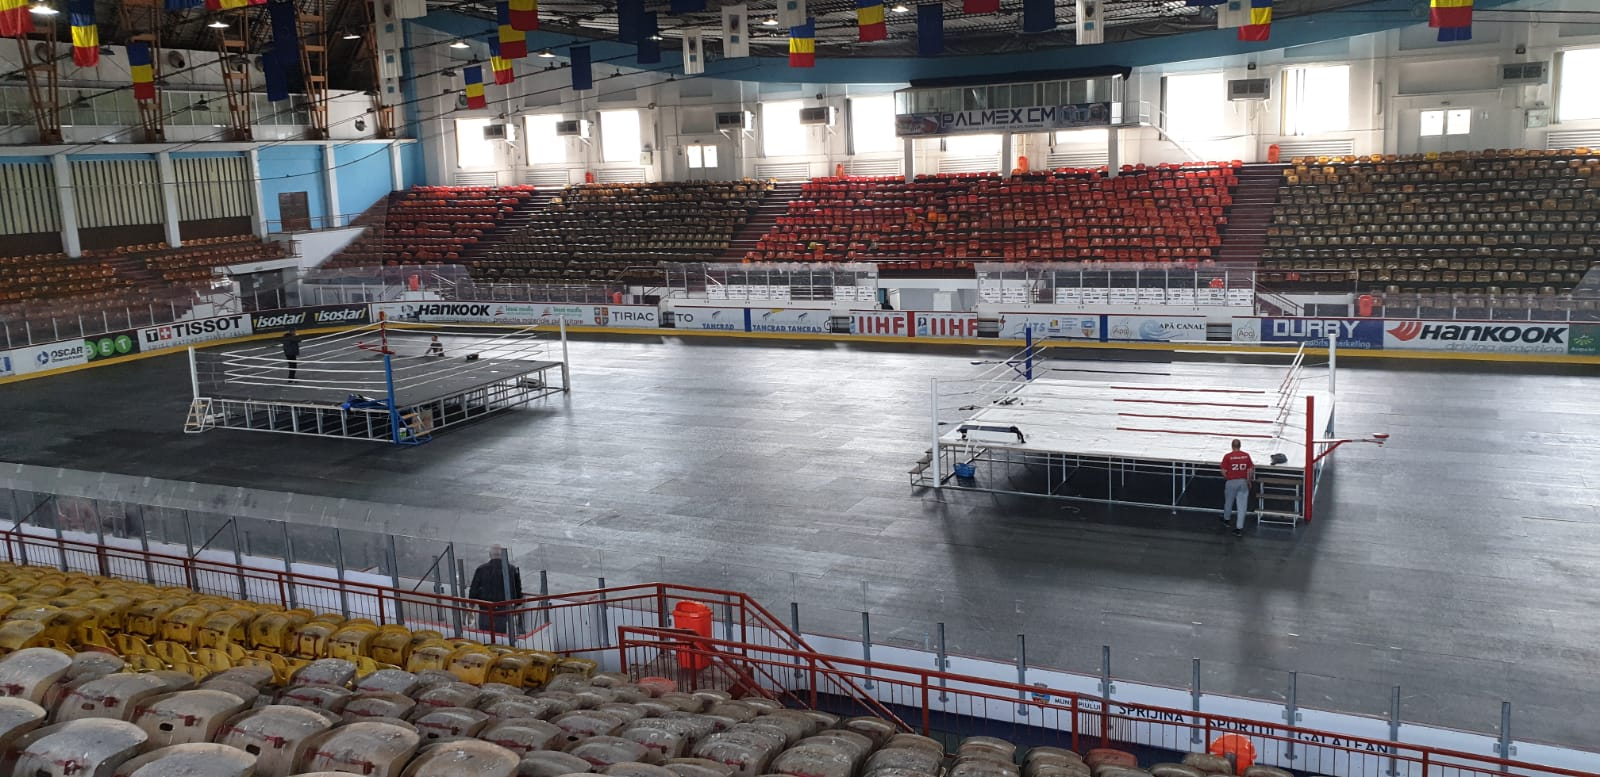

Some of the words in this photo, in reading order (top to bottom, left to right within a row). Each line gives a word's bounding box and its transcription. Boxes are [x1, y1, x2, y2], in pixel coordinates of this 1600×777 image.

[940, 108, 1023, 128] PALMEX
[1027, 106, 1056, 122] CM
[257, 312, 303, 328] isostar
[318, 308, 363, 322] isostar
[612, 311, 655, 322] TIRIAC
[676, 313, 694, 322] TO
[171, 316, 243, 338] TISSOT
[859, 316, 905, 335] IIHF
[931, 317, 978, 337] IIHF
[1273, 319, 1360, 339] DURBY
[51, 346, 84, 358] OSCAR
[1231, 463, 1247, 471] 20
